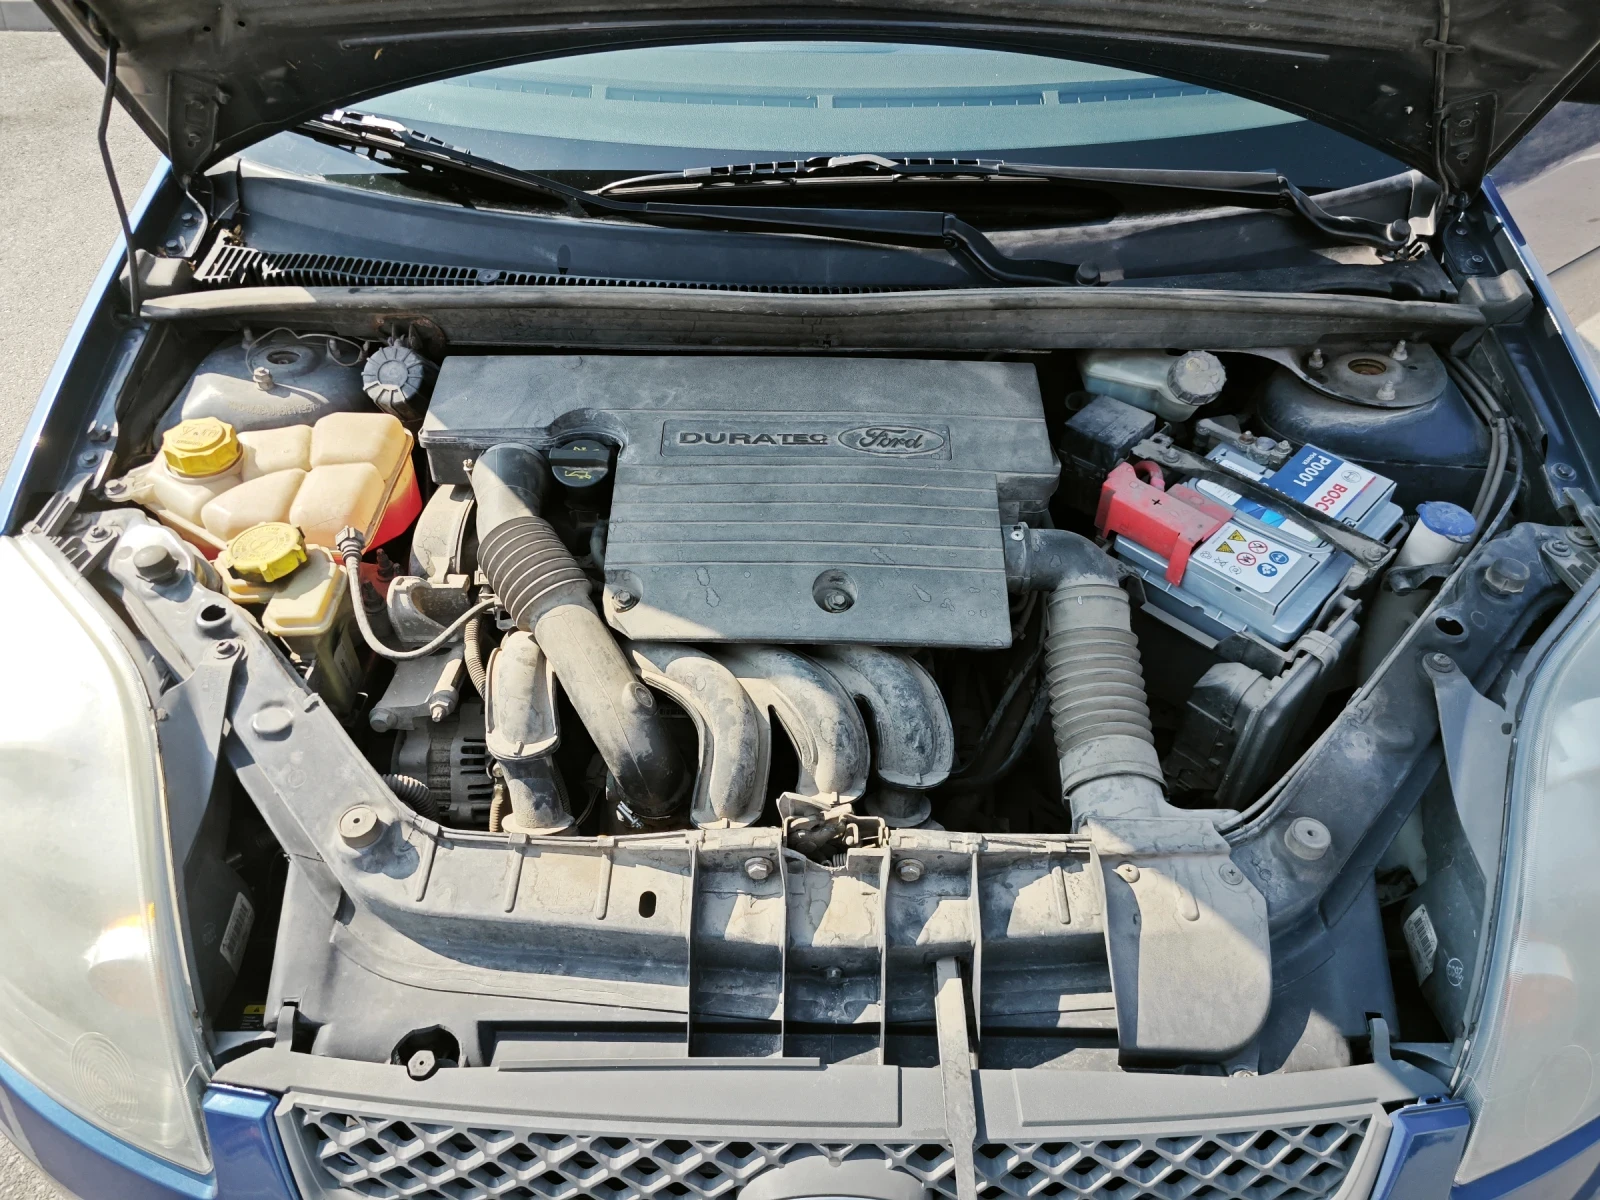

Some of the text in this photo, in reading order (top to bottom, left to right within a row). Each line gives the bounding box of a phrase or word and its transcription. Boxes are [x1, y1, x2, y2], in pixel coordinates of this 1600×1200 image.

[678, 427, 924, 449] DURATEC Ford
[1293, 455, 1332, 487] P0001
[1314, 483, 1348, 511] BOSC
